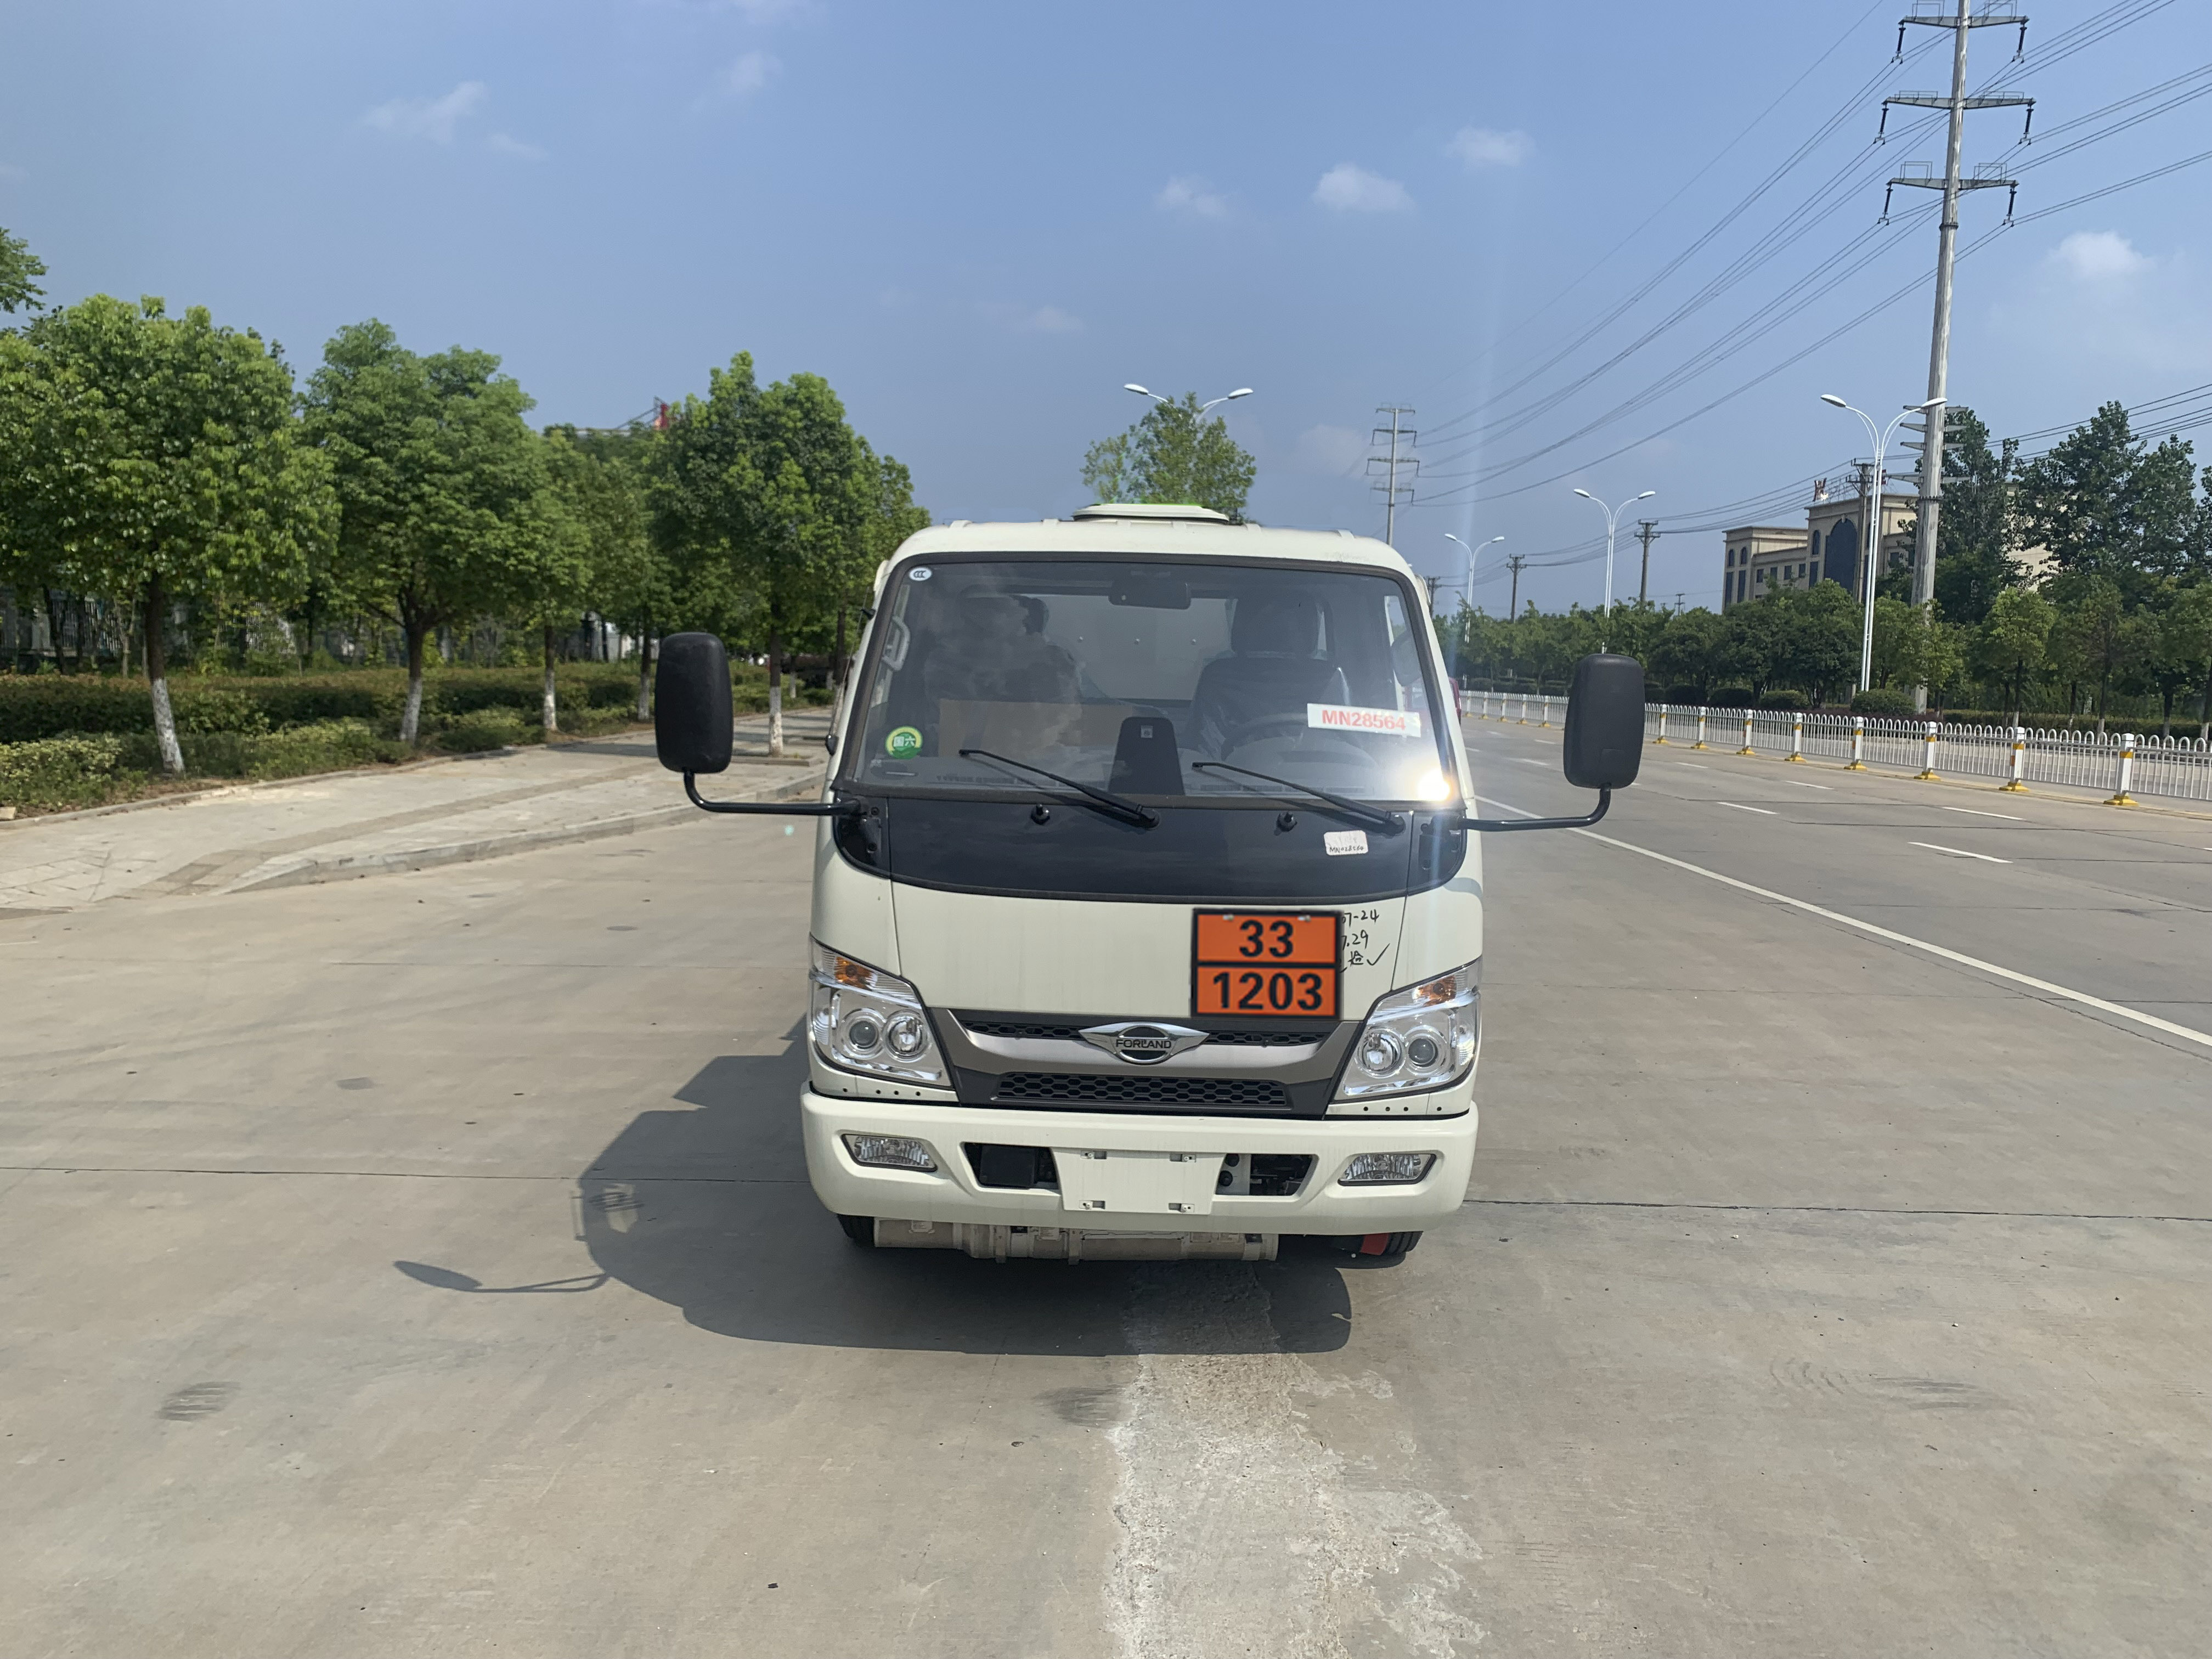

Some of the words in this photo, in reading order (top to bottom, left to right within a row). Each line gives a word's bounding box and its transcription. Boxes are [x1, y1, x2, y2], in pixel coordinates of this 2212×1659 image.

[1322, 710, 1406, 730] MN28564
[1239, 919, 1294, 958] 33
[1213, 972, 1322, 1011] 1203
[1115, 1039, 1172, 1049] FORLAND
